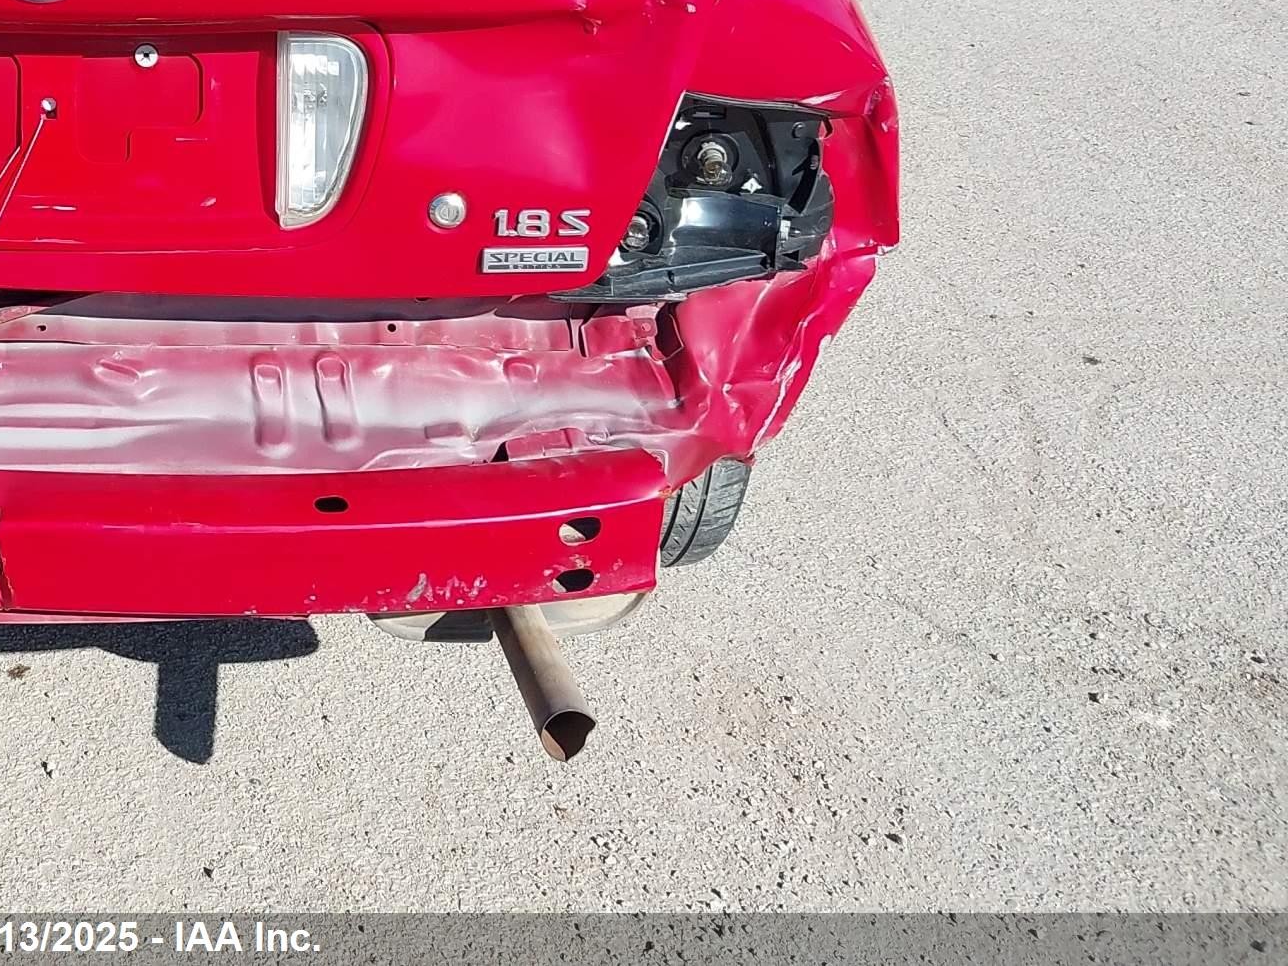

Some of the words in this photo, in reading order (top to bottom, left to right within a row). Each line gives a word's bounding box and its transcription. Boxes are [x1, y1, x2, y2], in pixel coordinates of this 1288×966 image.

[494, 209, 550, 237] 1.8
[558, 209, 591, 236] S
[488, 252, 583, 263] SPECIAL
